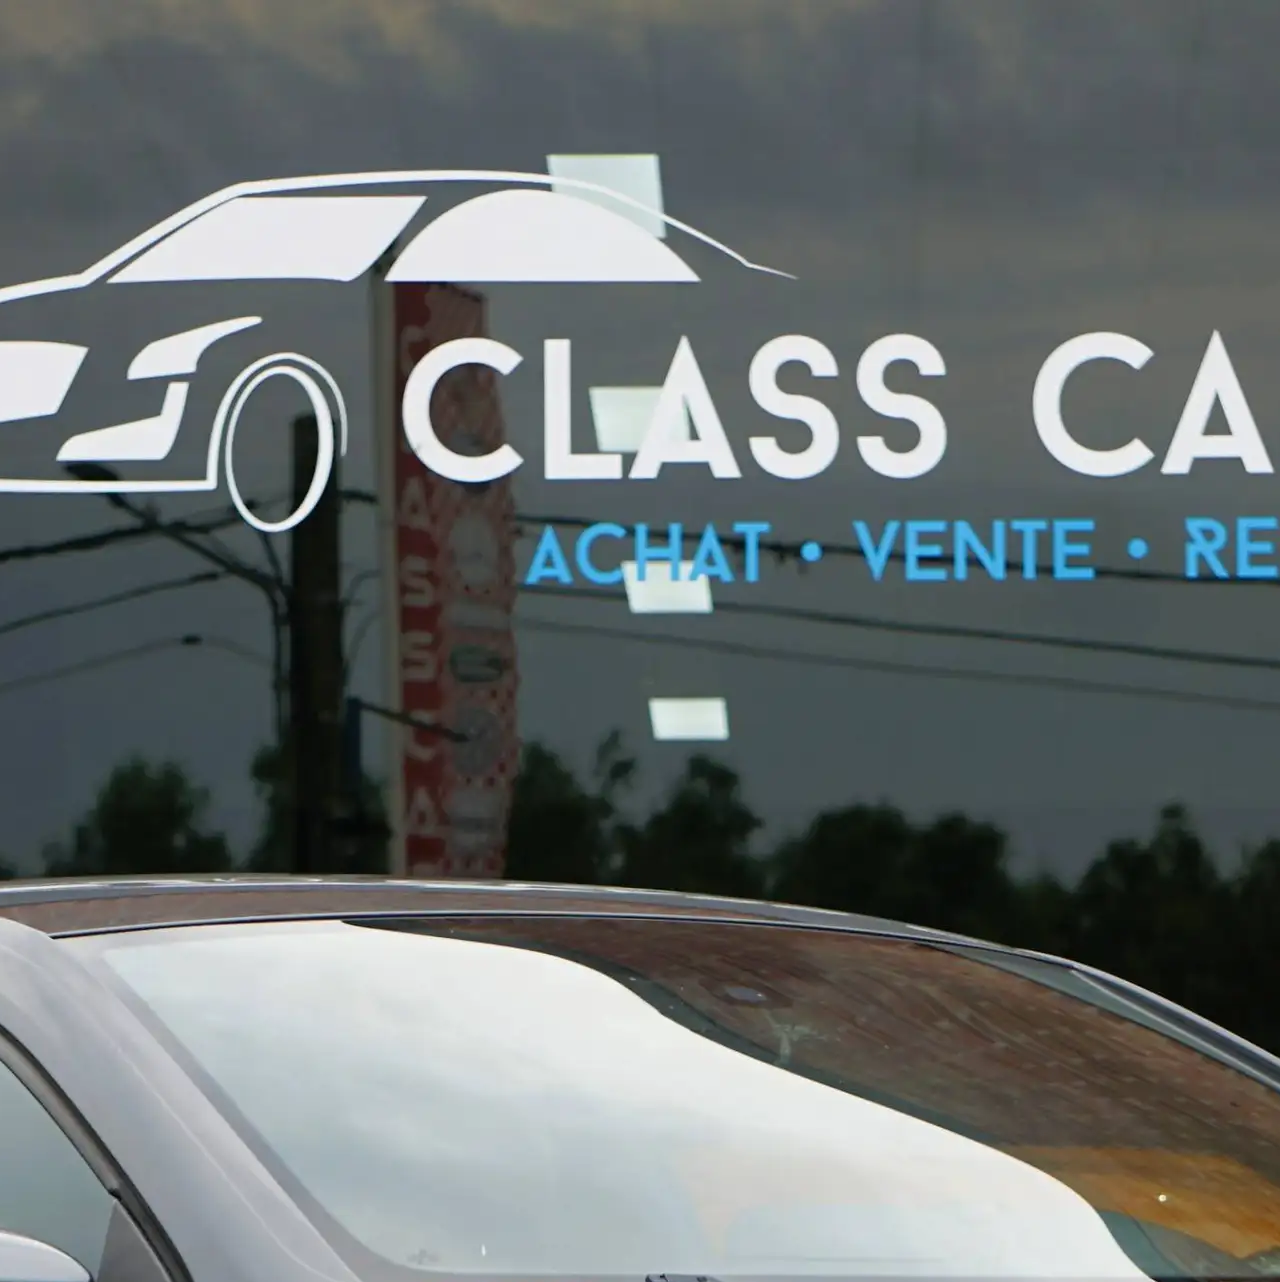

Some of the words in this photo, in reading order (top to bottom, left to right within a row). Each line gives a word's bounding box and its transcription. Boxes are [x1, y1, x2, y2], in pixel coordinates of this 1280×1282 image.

[402, 334, 947, 483] CLASS
[526, 522, 770, 585] ACHAT
[852, 520, 1096, 582] VENTE
